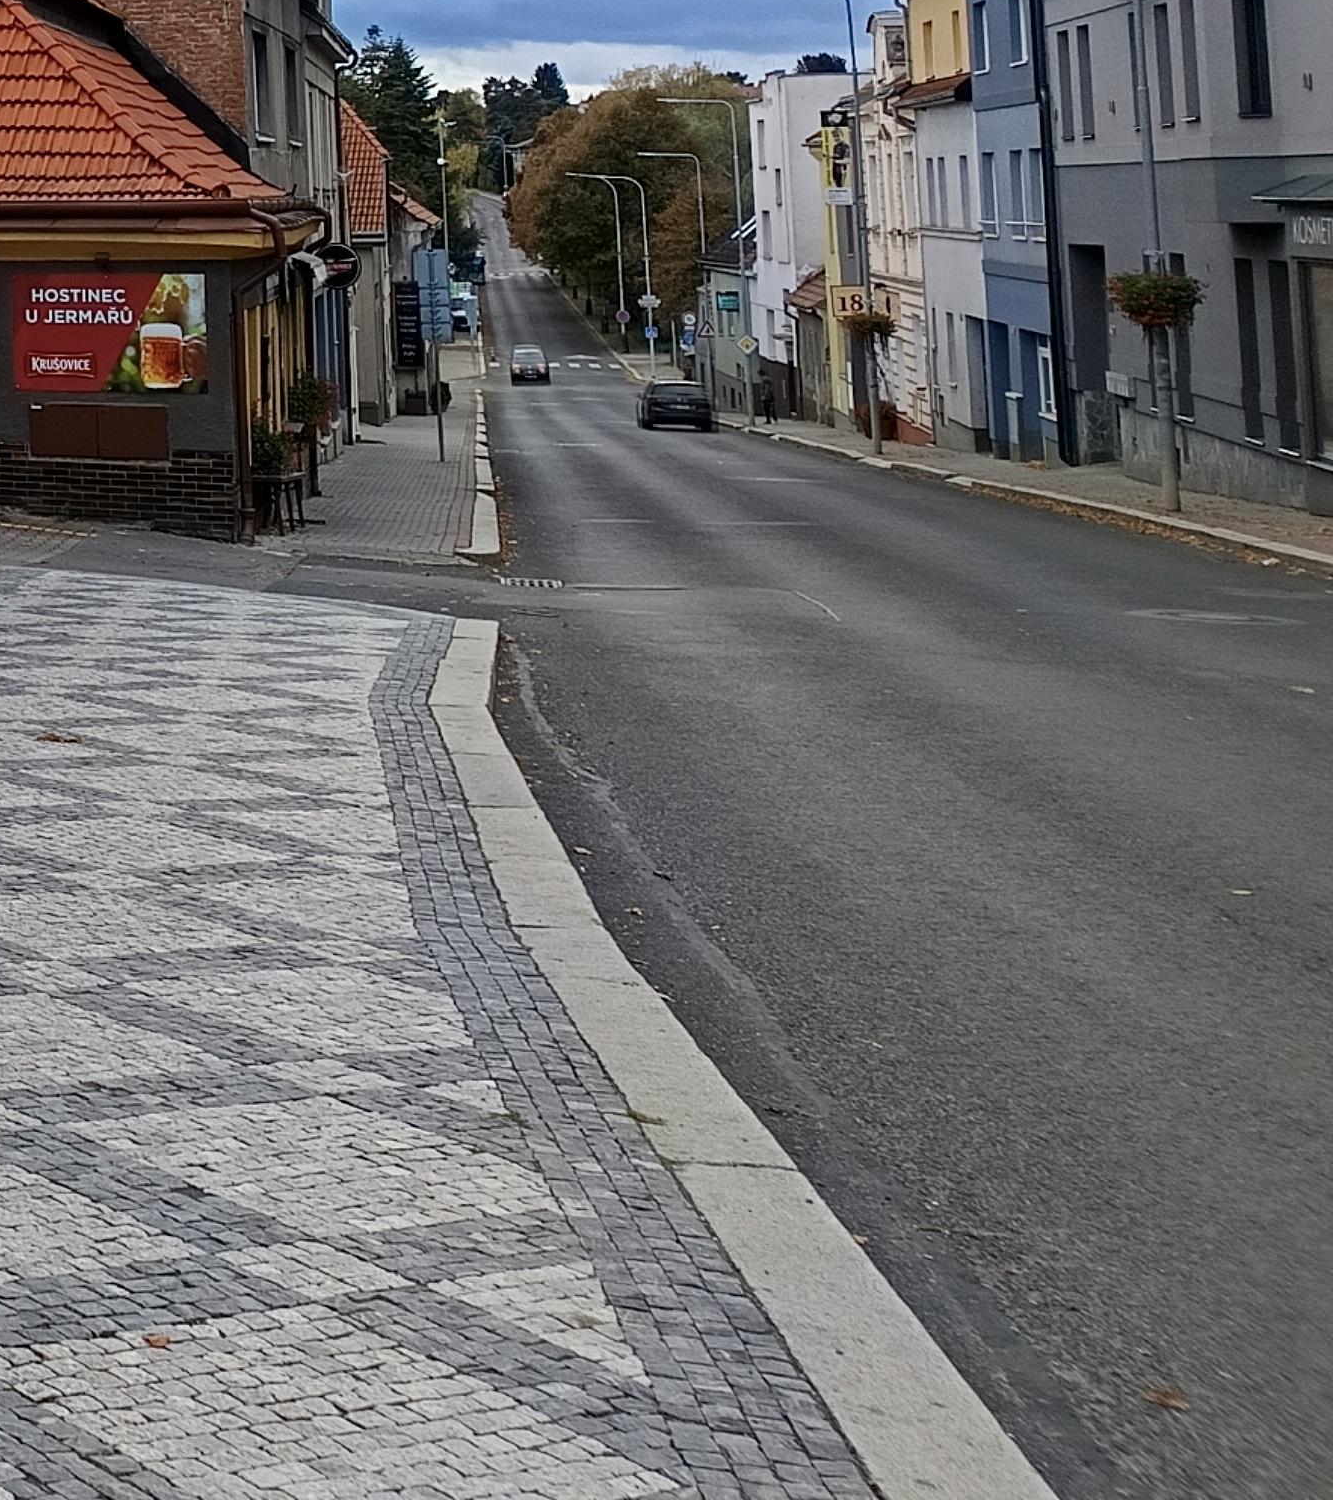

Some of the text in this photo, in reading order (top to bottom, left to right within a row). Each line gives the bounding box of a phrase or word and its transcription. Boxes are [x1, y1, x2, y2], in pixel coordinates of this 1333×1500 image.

[31, 288, 126, 304] HOSTINEC
[837, 293, 864, 313] 18
[25, 305, 133, 325] U JERMAŘŮ
[31, 356, 91, 374] KRUŠOVICE
